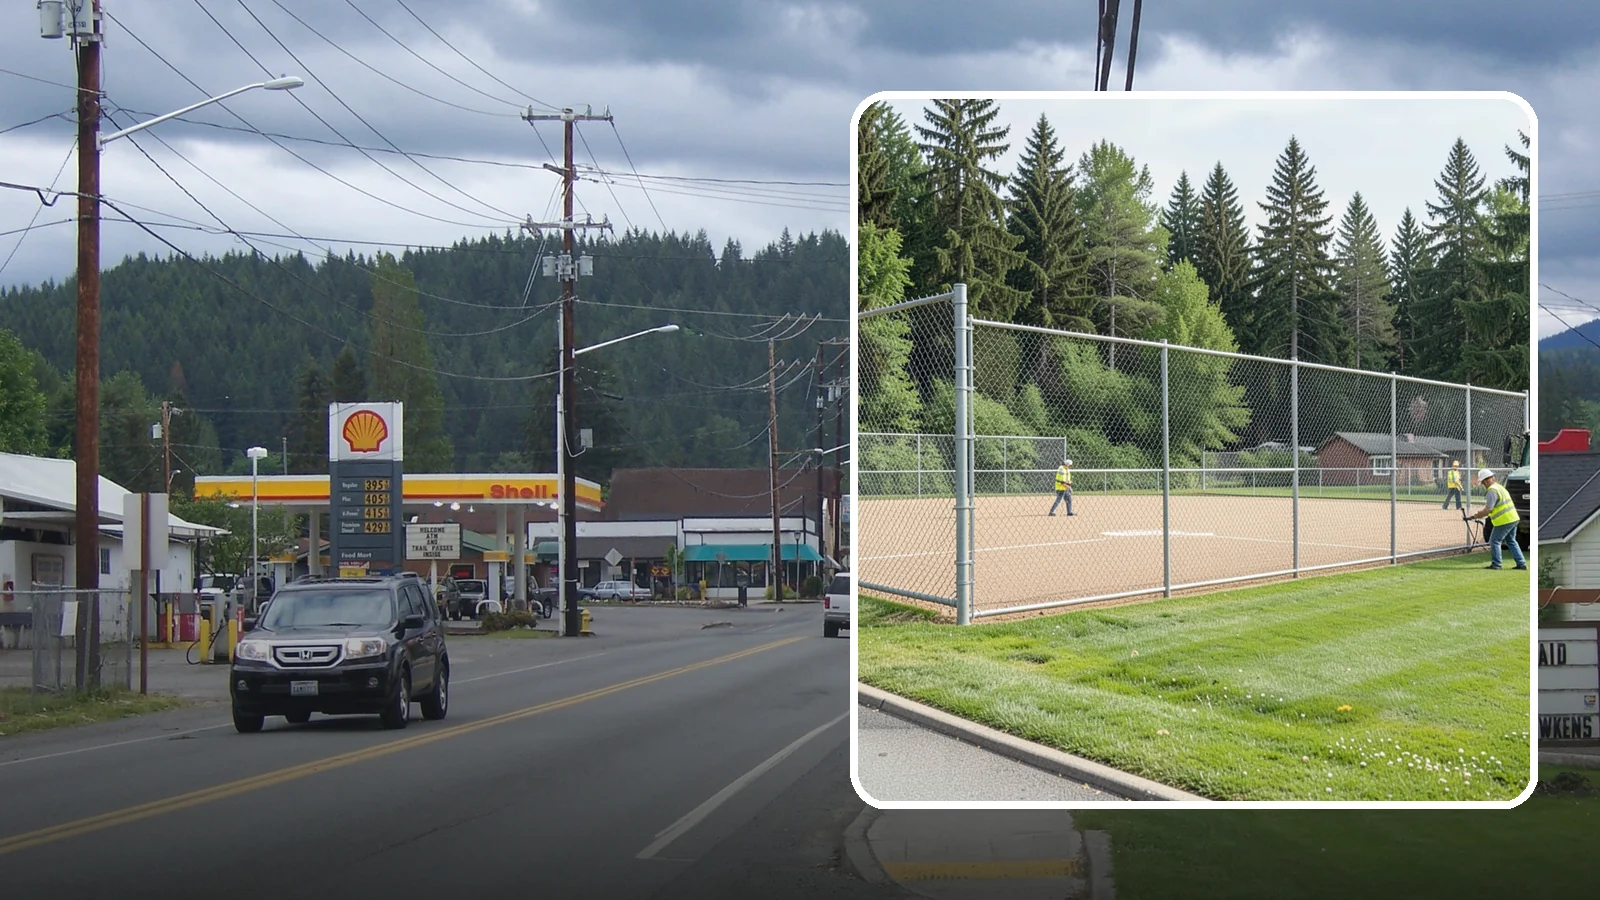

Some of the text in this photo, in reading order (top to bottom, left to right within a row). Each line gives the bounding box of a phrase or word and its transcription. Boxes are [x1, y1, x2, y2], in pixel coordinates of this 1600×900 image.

[365, 480, 384, 490] 395
[490, 484, 547, 499] Shell
[365, 494, 384, 504] 405
[365, 508, 384, 518] 415
[365, 522, 384, 532] 429
[1539, 643, 1567, 665] AID
